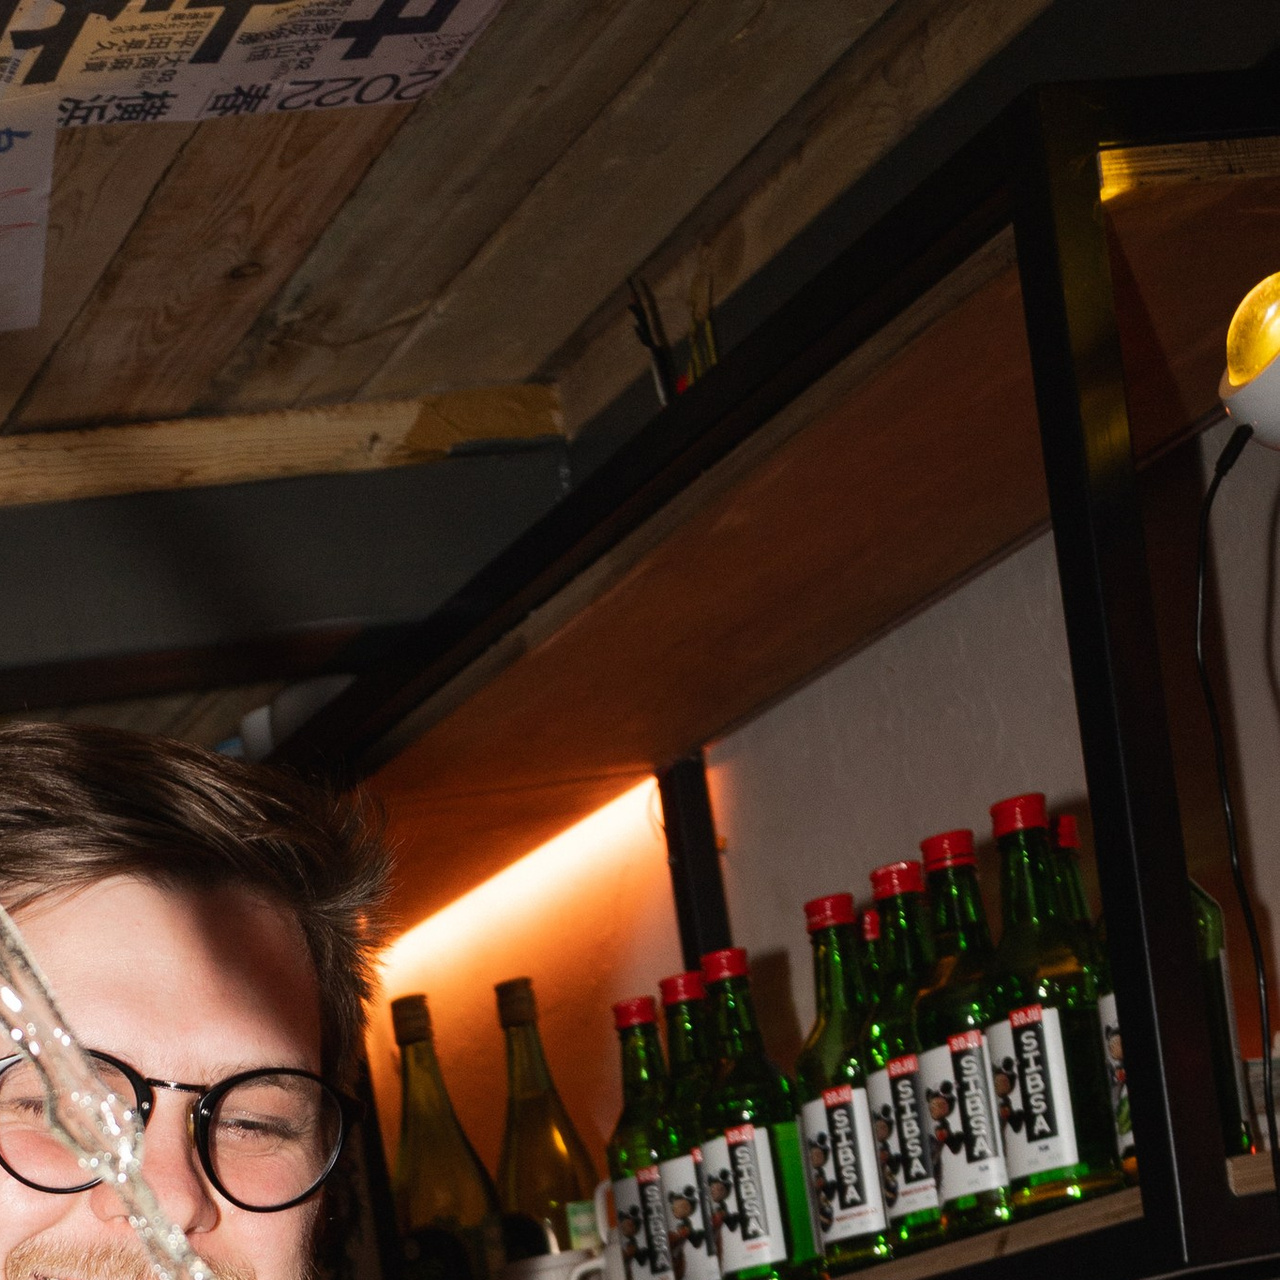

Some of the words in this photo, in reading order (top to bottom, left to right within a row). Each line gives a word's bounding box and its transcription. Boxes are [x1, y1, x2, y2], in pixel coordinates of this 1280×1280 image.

[57, 90, 176, 127] 横浜
[205, 86, 275, 117] 春
[278, 70, 444, 112] 2022
[897, 1079, 927, 1178] SIBSA
[960, 1056, 991, 1158] SIBSA
[1019, 1030, 1052, 1135] SIBSA
[735, 1146, 766, 1236] SIBSA
[832, 1108, 862, 1204] SIBSA
